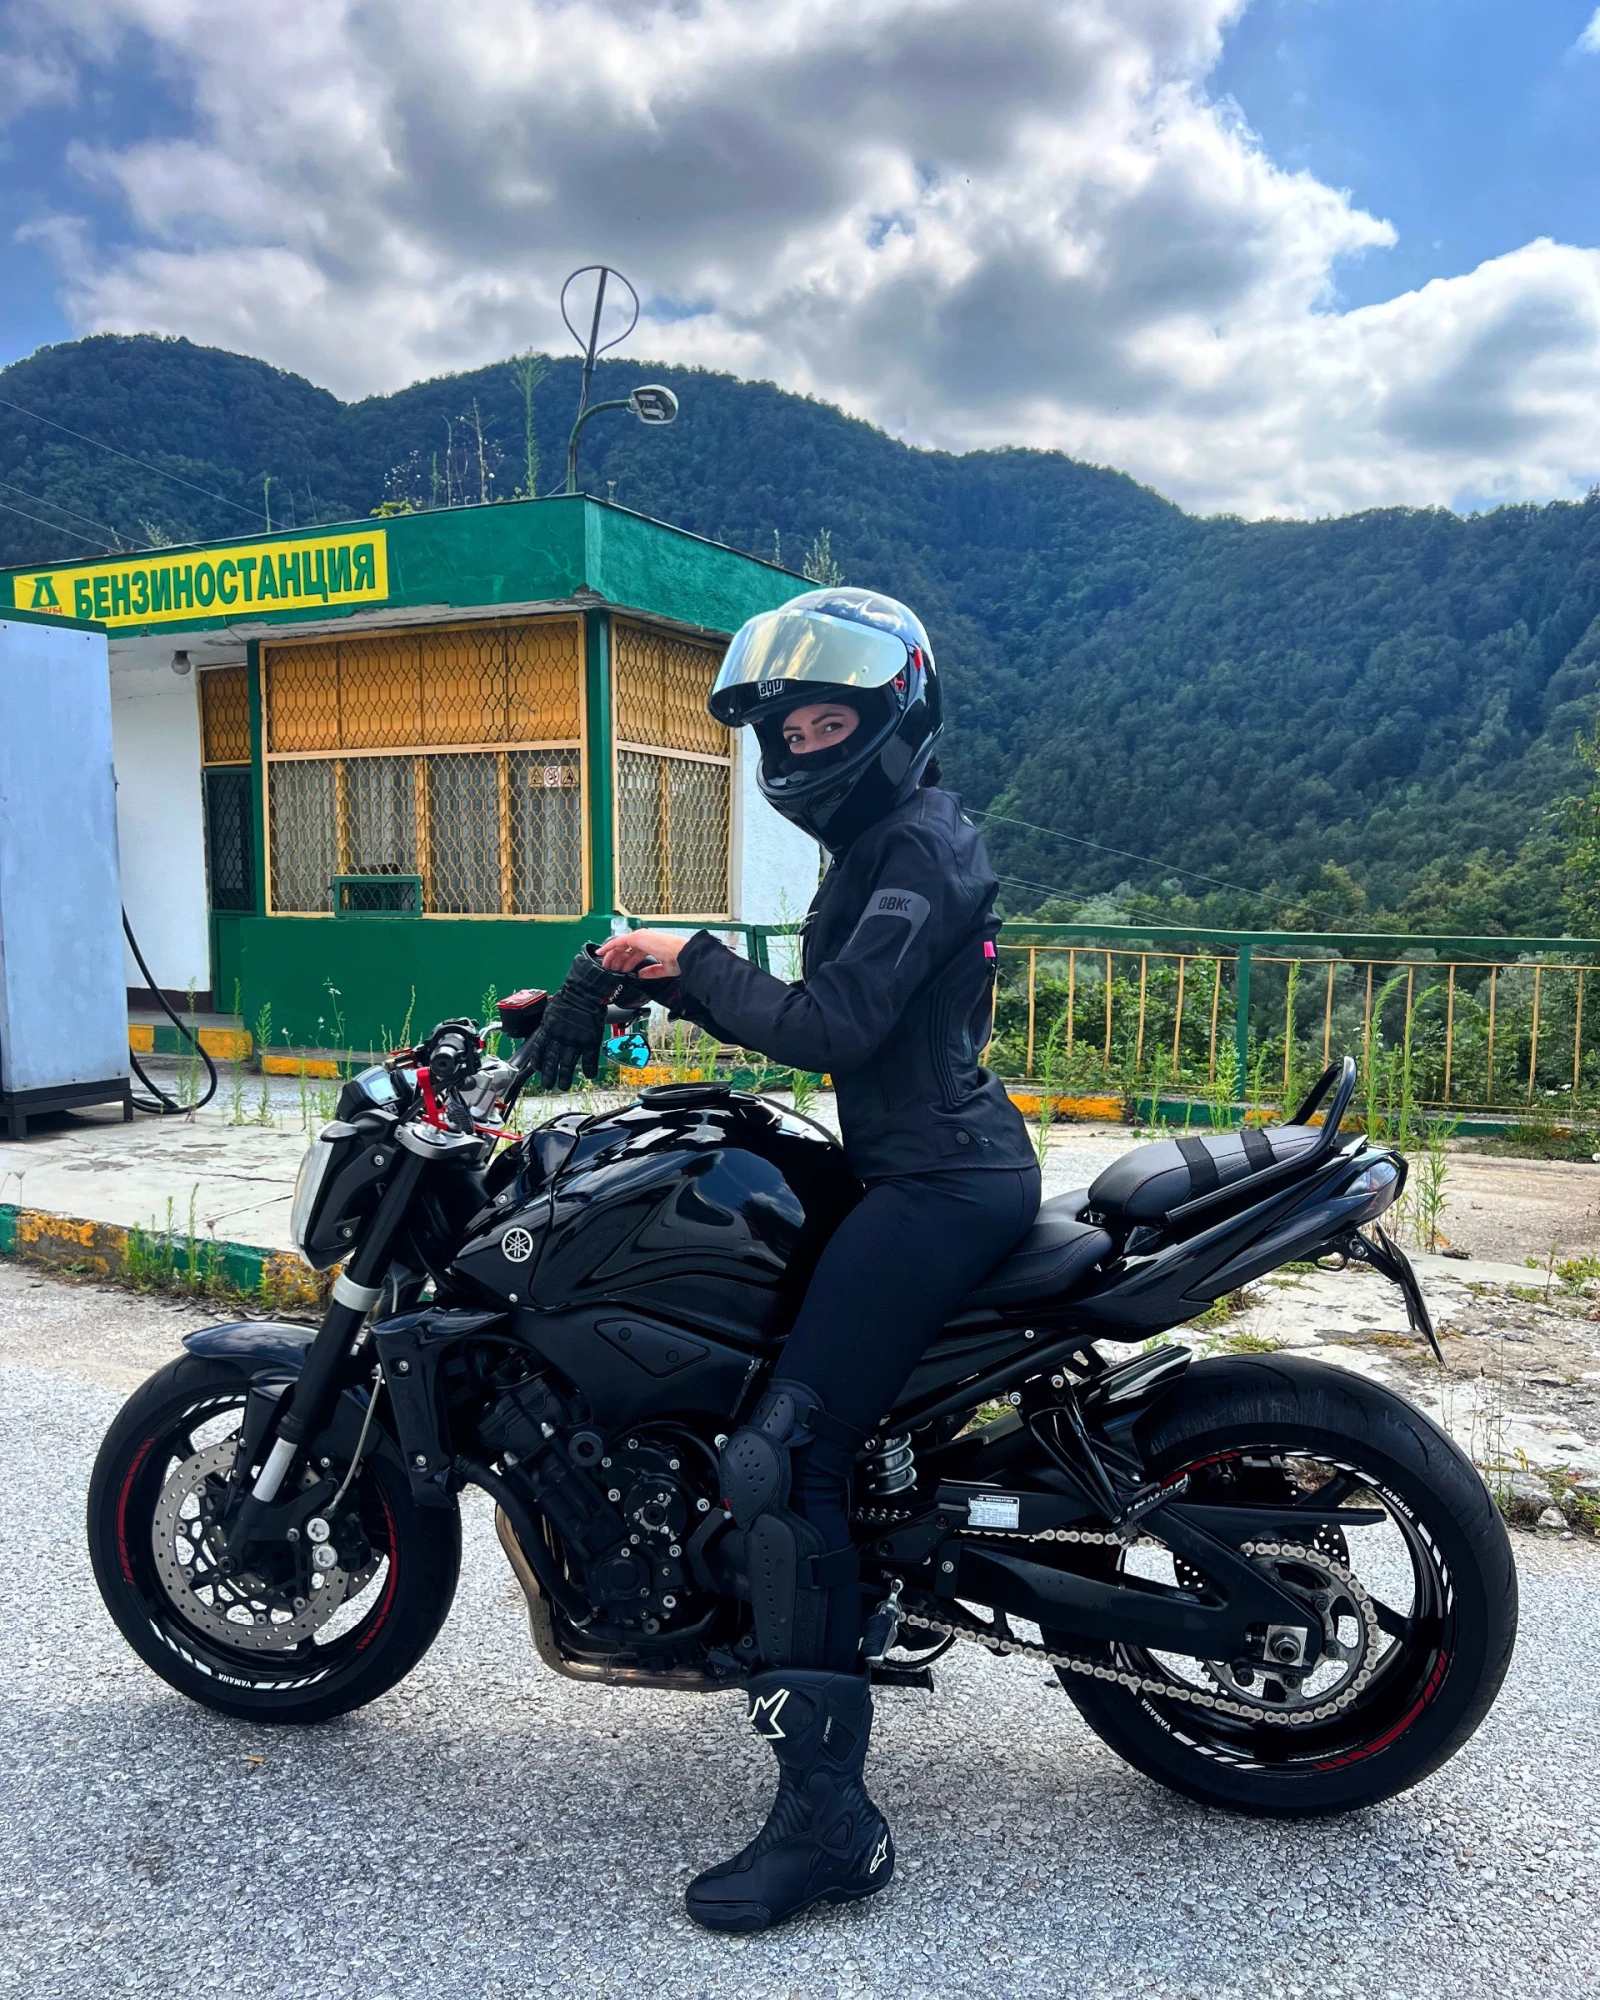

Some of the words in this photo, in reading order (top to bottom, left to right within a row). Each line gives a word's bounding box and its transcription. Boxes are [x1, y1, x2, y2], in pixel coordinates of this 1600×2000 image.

[74, 543, 375, 619] БЕНЗИНОСТАНЦИЯ
[1381, 1486, 1414, 1519] YAMAHA
[218, 1672, 252, 1688] YAMAHA
[1141, 1698, 1171, 1732] YAMAHA
